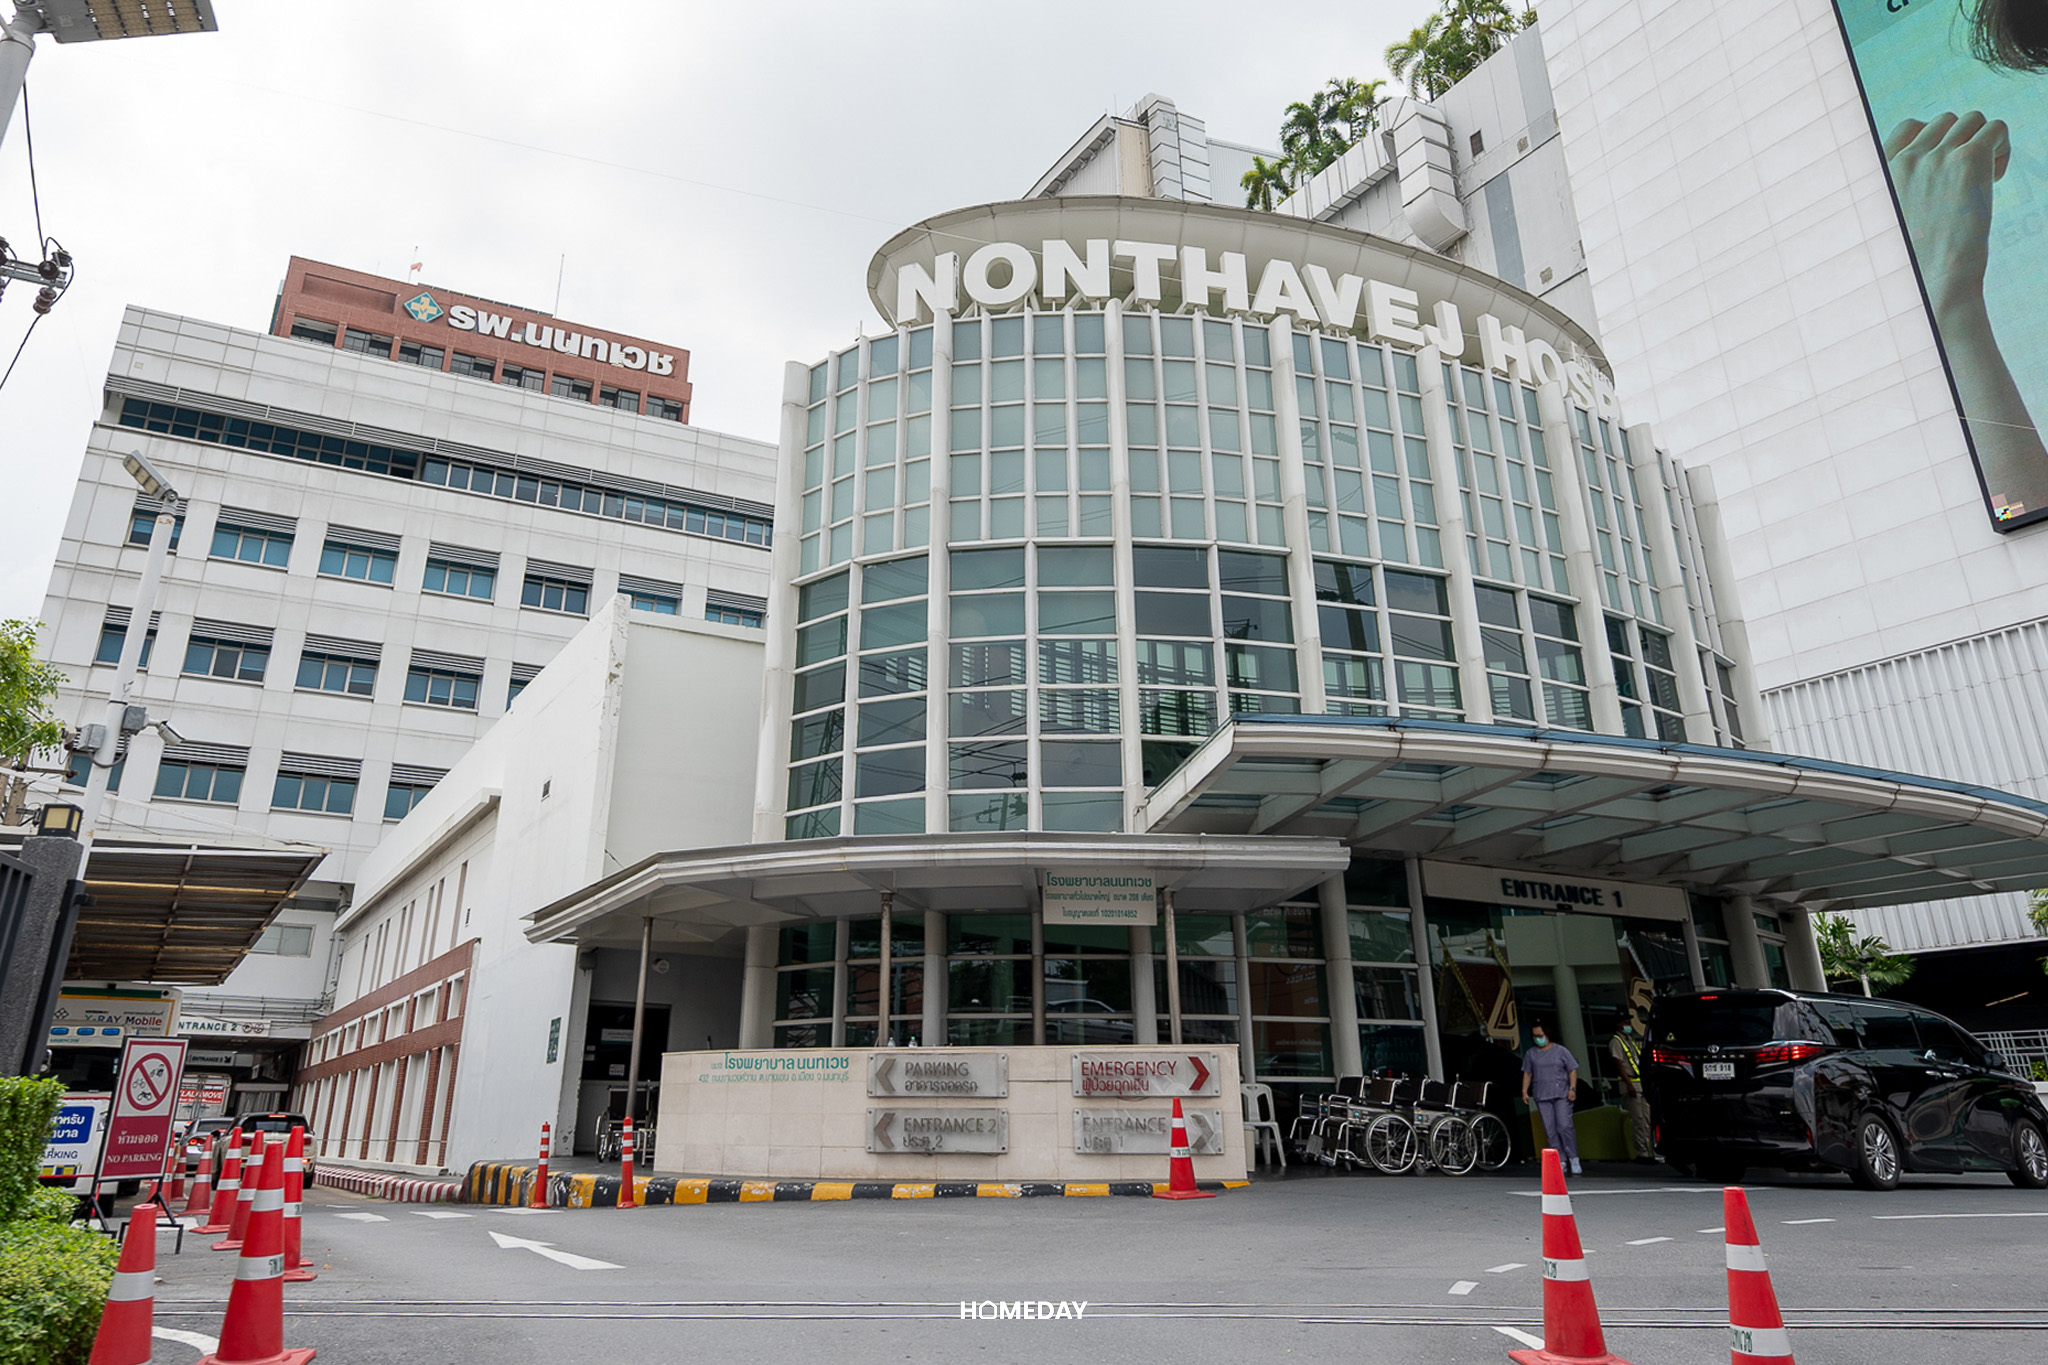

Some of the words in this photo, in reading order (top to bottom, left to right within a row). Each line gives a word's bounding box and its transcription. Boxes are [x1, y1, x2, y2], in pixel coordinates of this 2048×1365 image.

[898, 239, 1465, 357] NONTHAVEJ
[1046, 872, 1152, 887] โรงพยาบาลนนทเวช
[1500, 878, 1605, 907] ENTRANCE
[1612, 890, 1623, 908] 1
[125, 1016, 162, 1026] Mobile
[178, 1021, 228, 1032] NTRANCE
[230, 1022, 238, 1031] 2
[904, 1061, 970, 1077] PARKING
[1081, 1060, 1177, 1076] EMERGENCY
[1081, 1077, 1150, 1096] ผู้ป่วยฉุกเฉิน
[904, 1117, 984, 1133] ENTRANCE
[988, 1118, 997, 1134] 2
[1083, 1117, 1168, 1133] ENTRANCE
[117, 1130, 159, 1145] ห้ามจอด
[935, 1134, 943, 1148] 2
[45, 1150, 79, 1160] RKING
[106, 1155, 121, 1164] NO
[122, 1153, 162, 1163] PARKING
